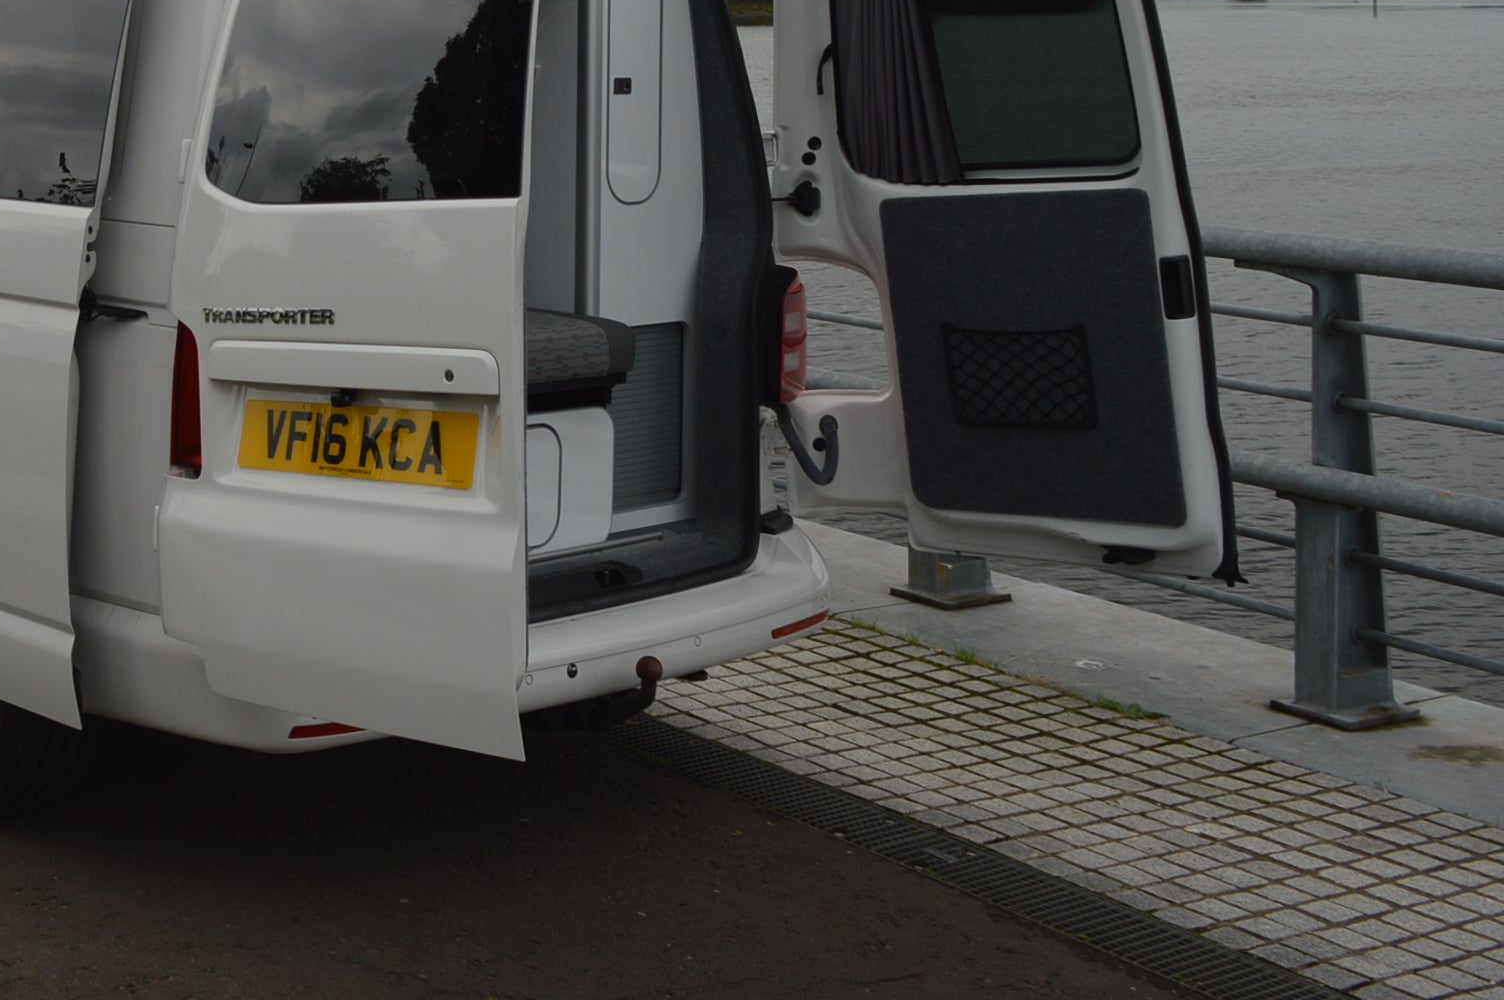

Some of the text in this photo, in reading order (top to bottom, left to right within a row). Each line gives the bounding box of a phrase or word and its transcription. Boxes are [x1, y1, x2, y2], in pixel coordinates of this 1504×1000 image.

[202, 307, 335, 325] TRANSPORTER
[266, 408, 443, 475] VF16 KCA
